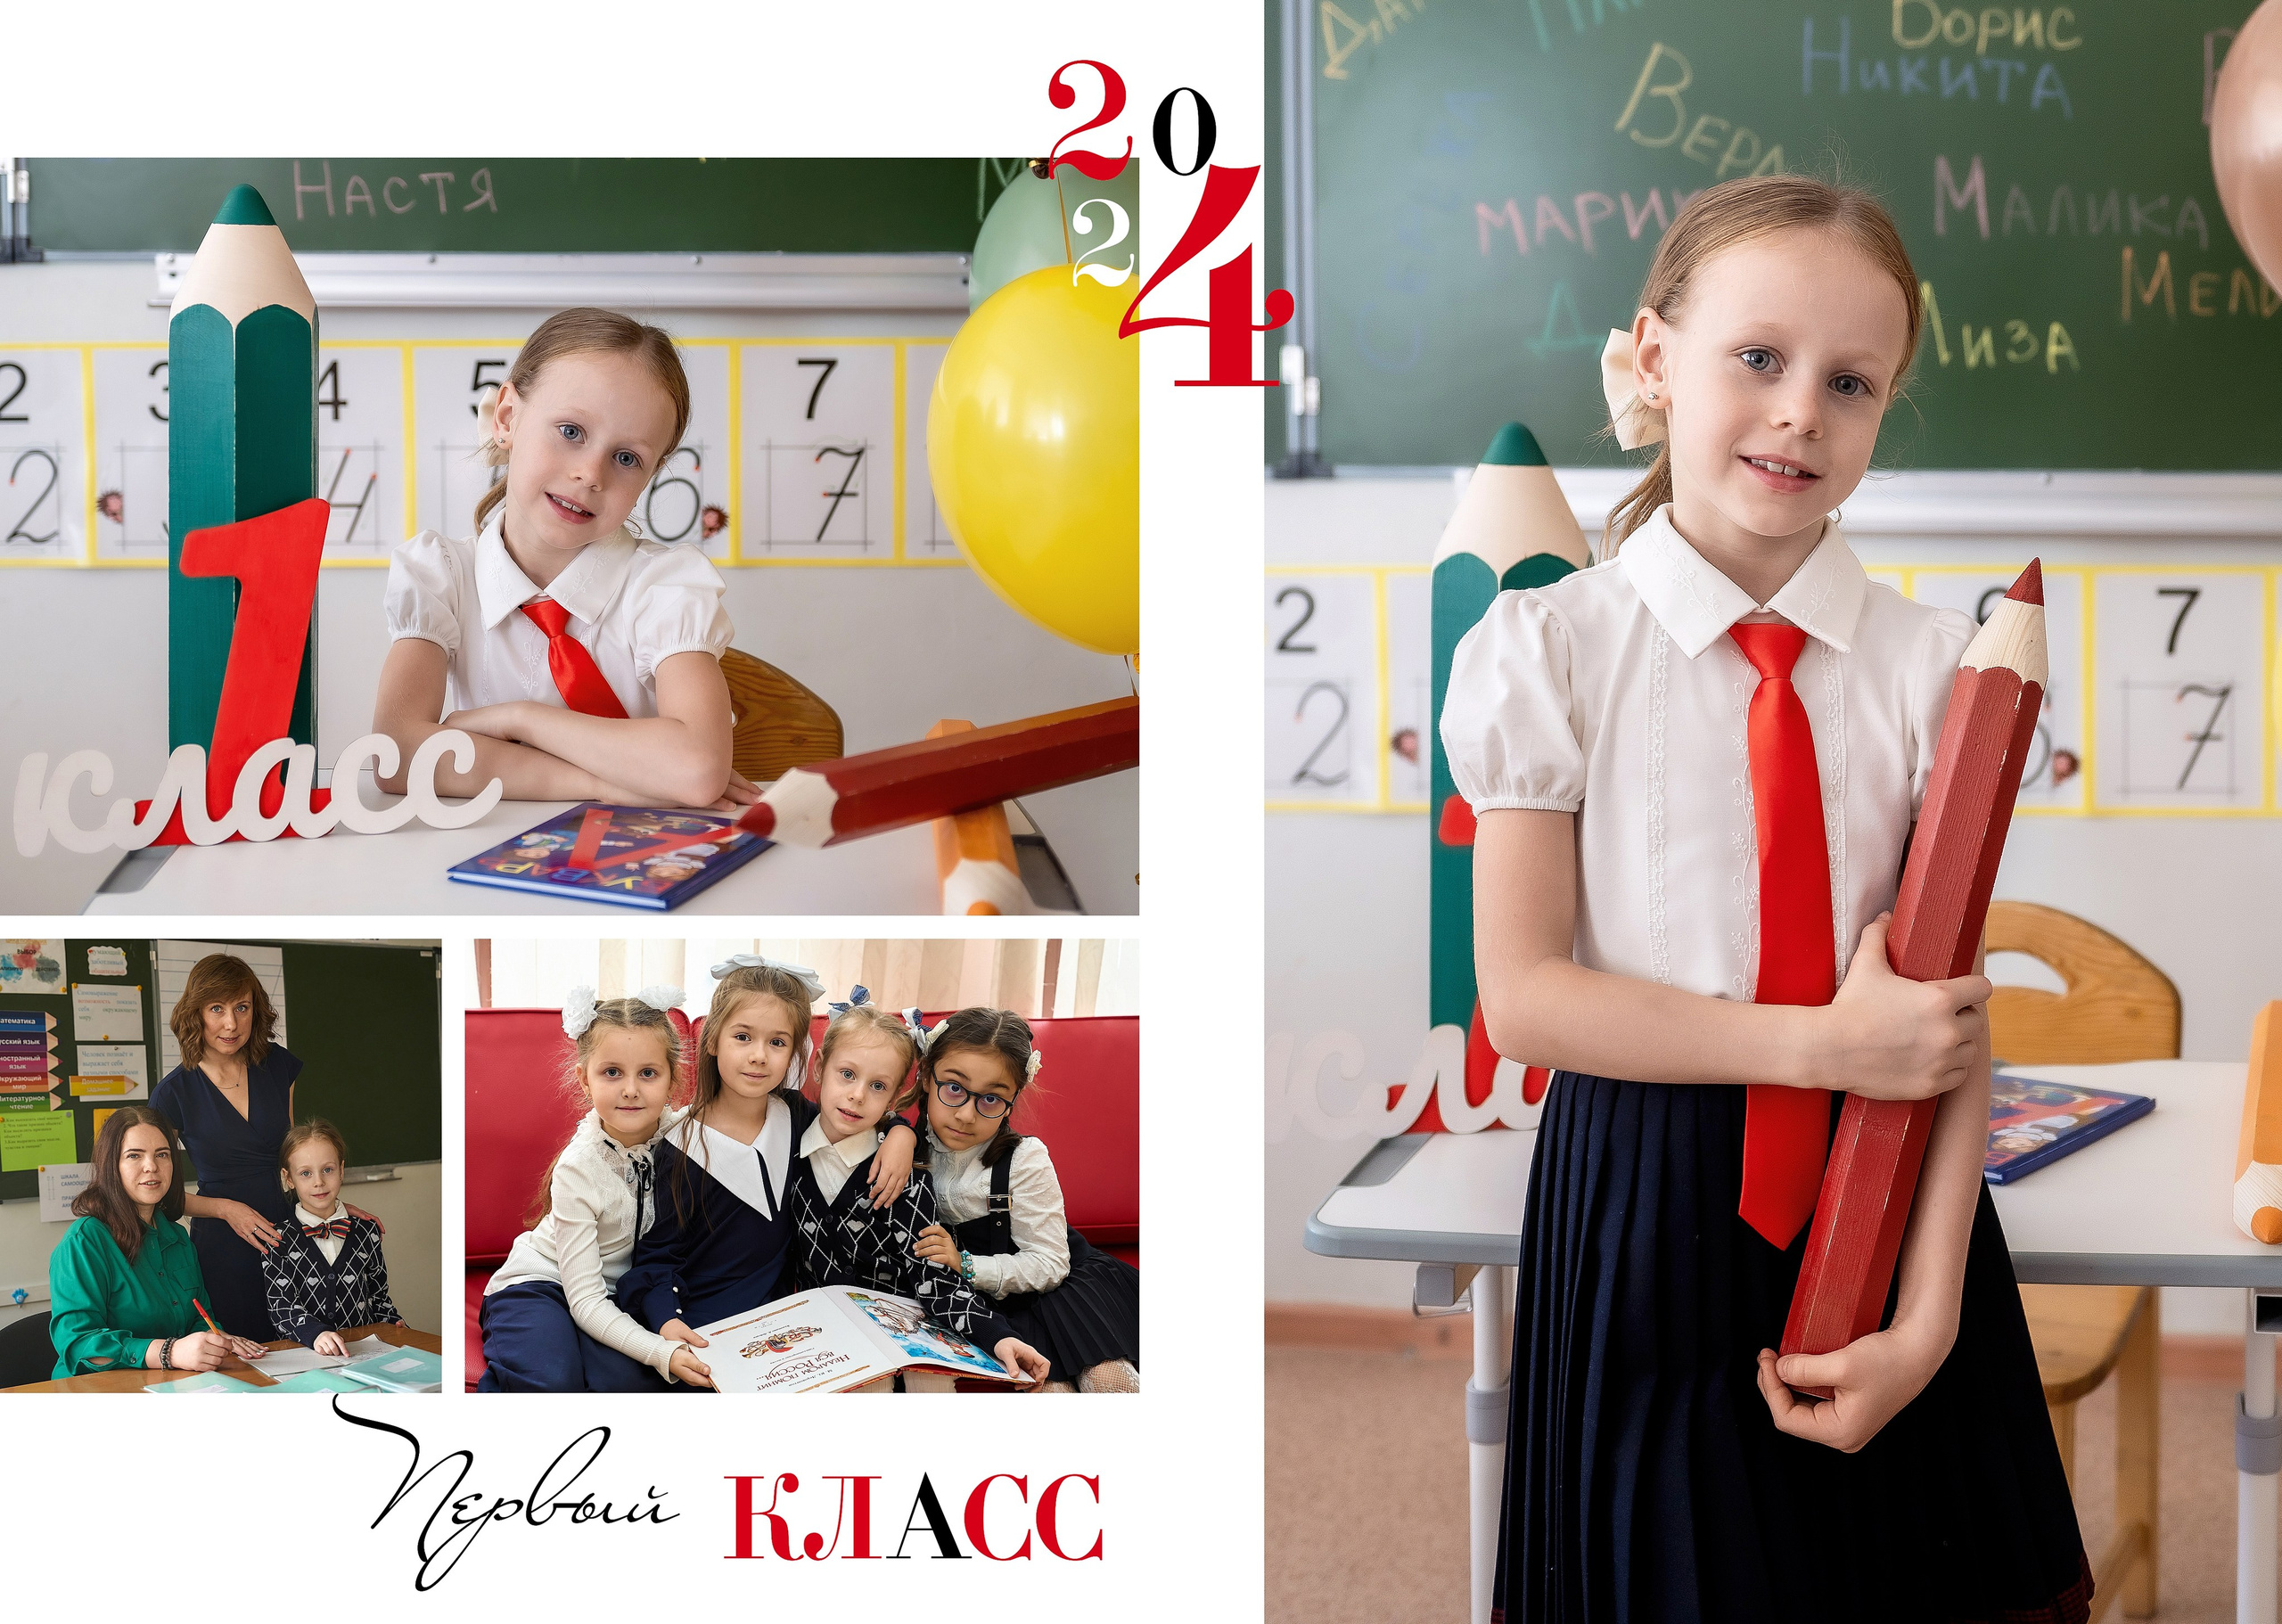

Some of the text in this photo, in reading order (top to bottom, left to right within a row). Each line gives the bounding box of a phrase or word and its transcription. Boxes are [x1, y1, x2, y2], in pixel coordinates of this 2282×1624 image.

[797, 358, 838, 420] 7
[7, 449, 58, 543] 2
[815, 446, 866, 543] 7
[1275, 586, 1317, 655] 2
[2155, 587, 2202, 657] 7
[1291, 680, 1350, 785] 2
[2175, 683, 2234, 791] 7
[13, 728, 503, 857] класс
[0, 1075, 42, 1083] кружающий
